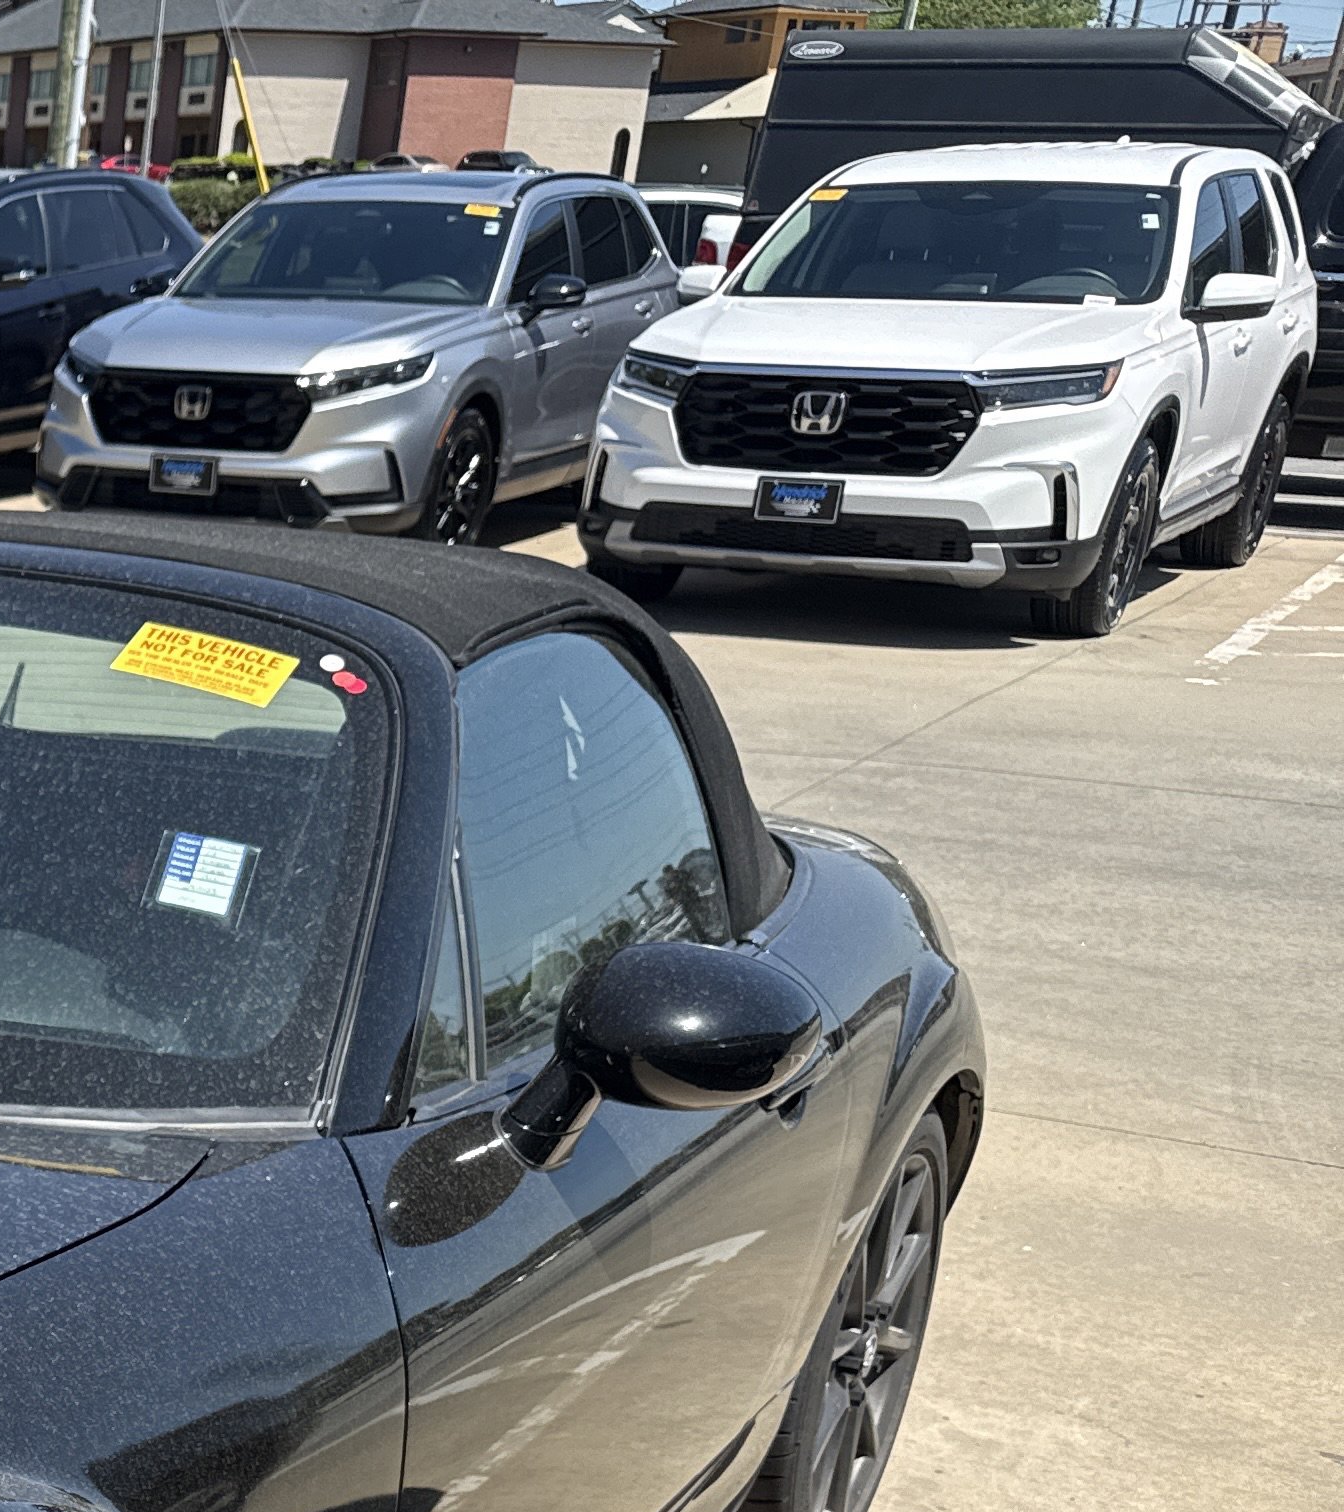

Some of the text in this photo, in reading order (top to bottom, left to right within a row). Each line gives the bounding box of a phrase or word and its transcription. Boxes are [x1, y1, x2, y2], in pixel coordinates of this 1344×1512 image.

[140, 640, 178, 655] NOT
[180, 648, 219, 665] FOR
[222, 659, 270, 679] SALE
[146, 628, 192, 646] THIS
[198, 638, 283, 669] VEHICLE
